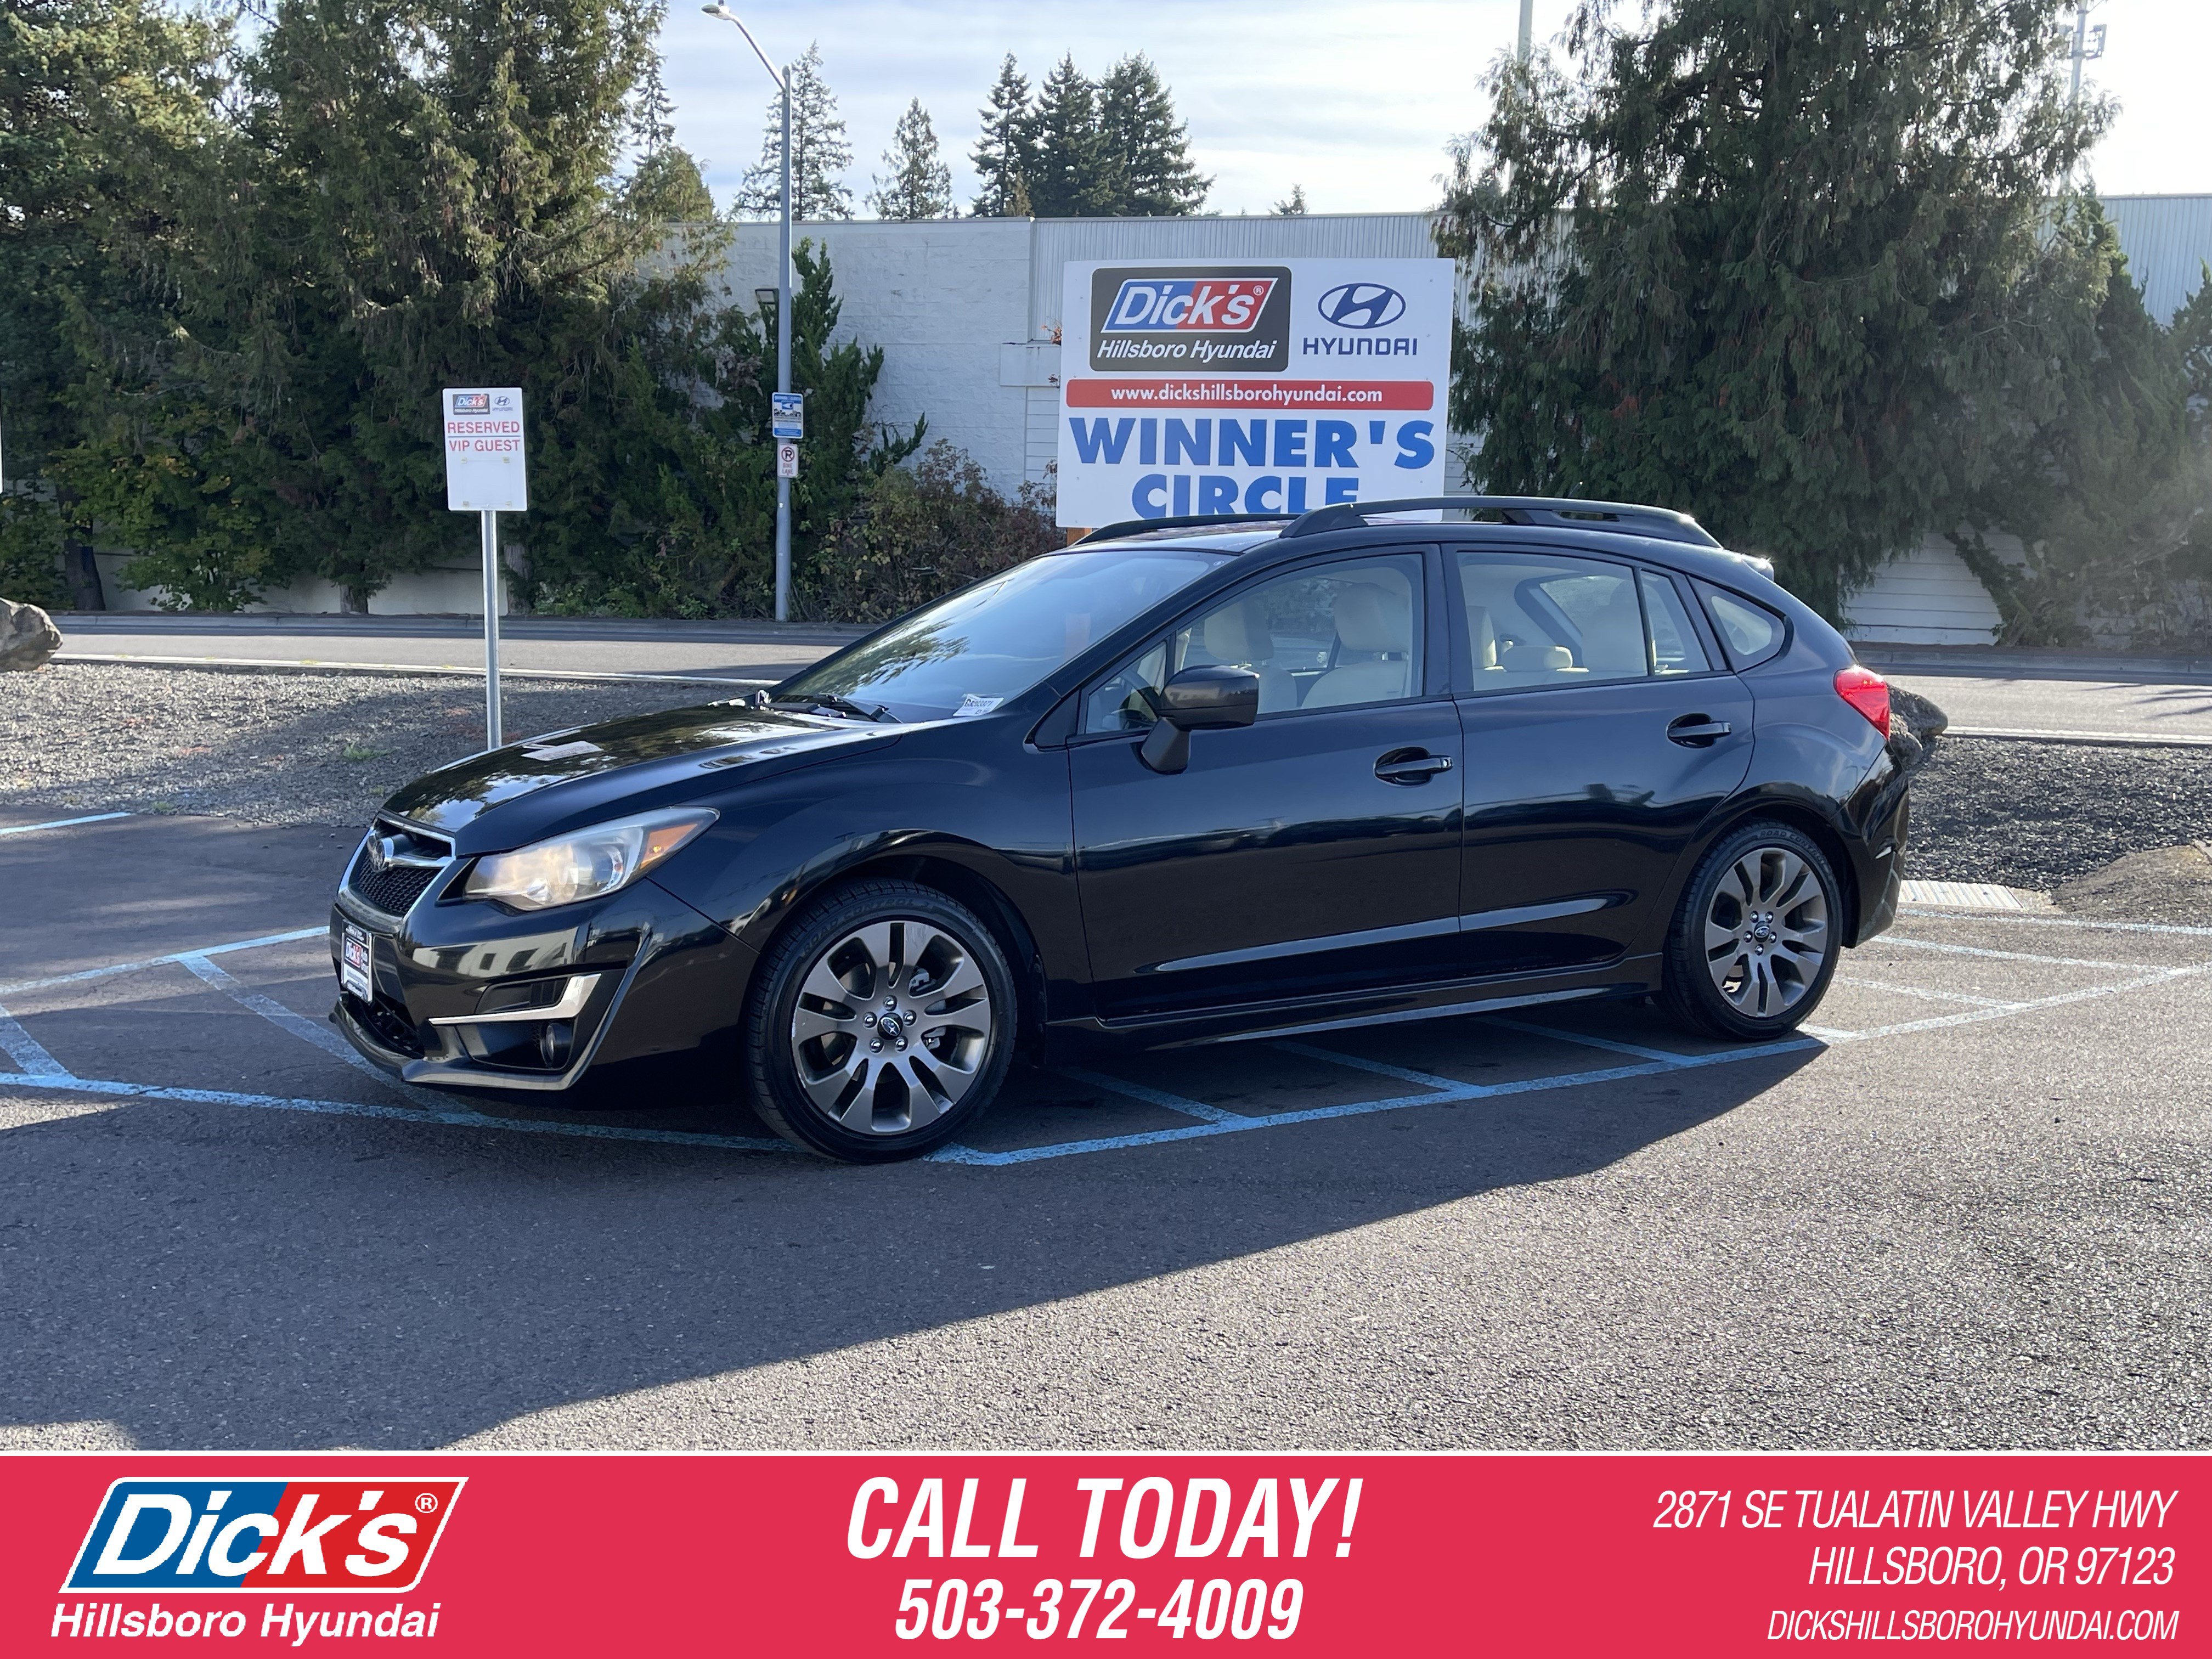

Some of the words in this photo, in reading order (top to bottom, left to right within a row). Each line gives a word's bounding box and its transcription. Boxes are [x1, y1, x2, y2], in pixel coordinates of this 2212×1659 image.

[1097, 339, 1187, 358] Hillsboro
[1189, 339, 1278, 363] Hyundai
[1303, 337, 1418, 356] HYUNDAI
[1111, 383, 1383, 406] www.dickshillsborohyundai.com
[447, 421, 520, 433] RESERVED
[449, 439, 470, 452] VIP
[475, 439, 521, 452] GUEST
[1069, 417, 1435, 470] WINNER'S
